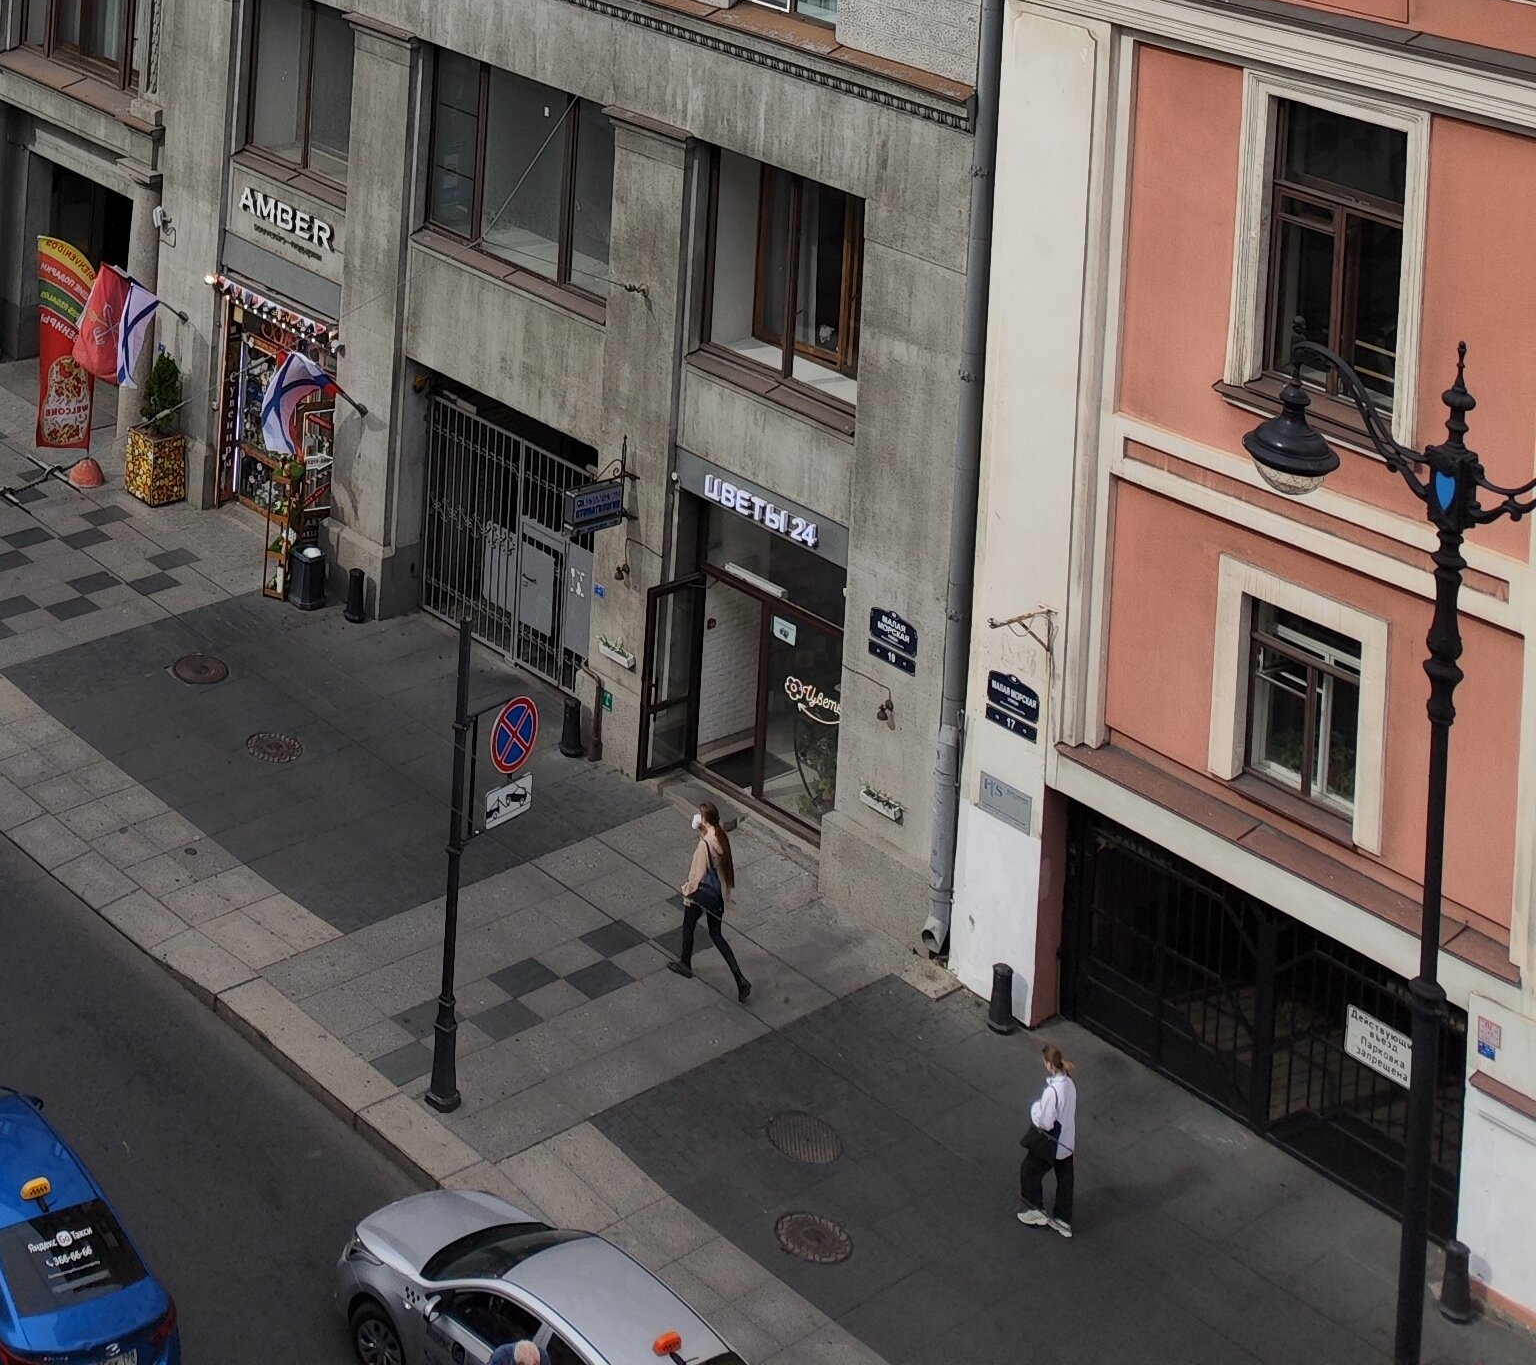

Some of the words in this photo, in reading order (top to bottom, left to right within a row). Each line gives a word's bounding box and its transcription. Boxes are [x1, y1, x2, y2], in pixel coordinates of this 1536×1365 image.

[238, 186, 332, 252] AMBER
[704, 474, 789, 533] ЦВЕТЫ
[790, 517, 818, 547] 24
[877, 621, 910, 643] МОРСКАЯ
[882, 615, 906, 633] МАЛАЯ
[992, 679, 1010, 695] МАЛАЯ
[1011, 689, 1037, 709] МОРСКАЯ
[1007, 718, 1015, 729] 17
[1351, 1009, 1412, 1049] Действующи
[1370, 1031, 1398, 1053] въезд
[1356, 1047, 1408, 1081] запрещена
[1361, 1036, 1405, 1069] Парковка
[28, 1239, 58, 1253] Яндекс
[70, 1227, 93, 1241] Такси
